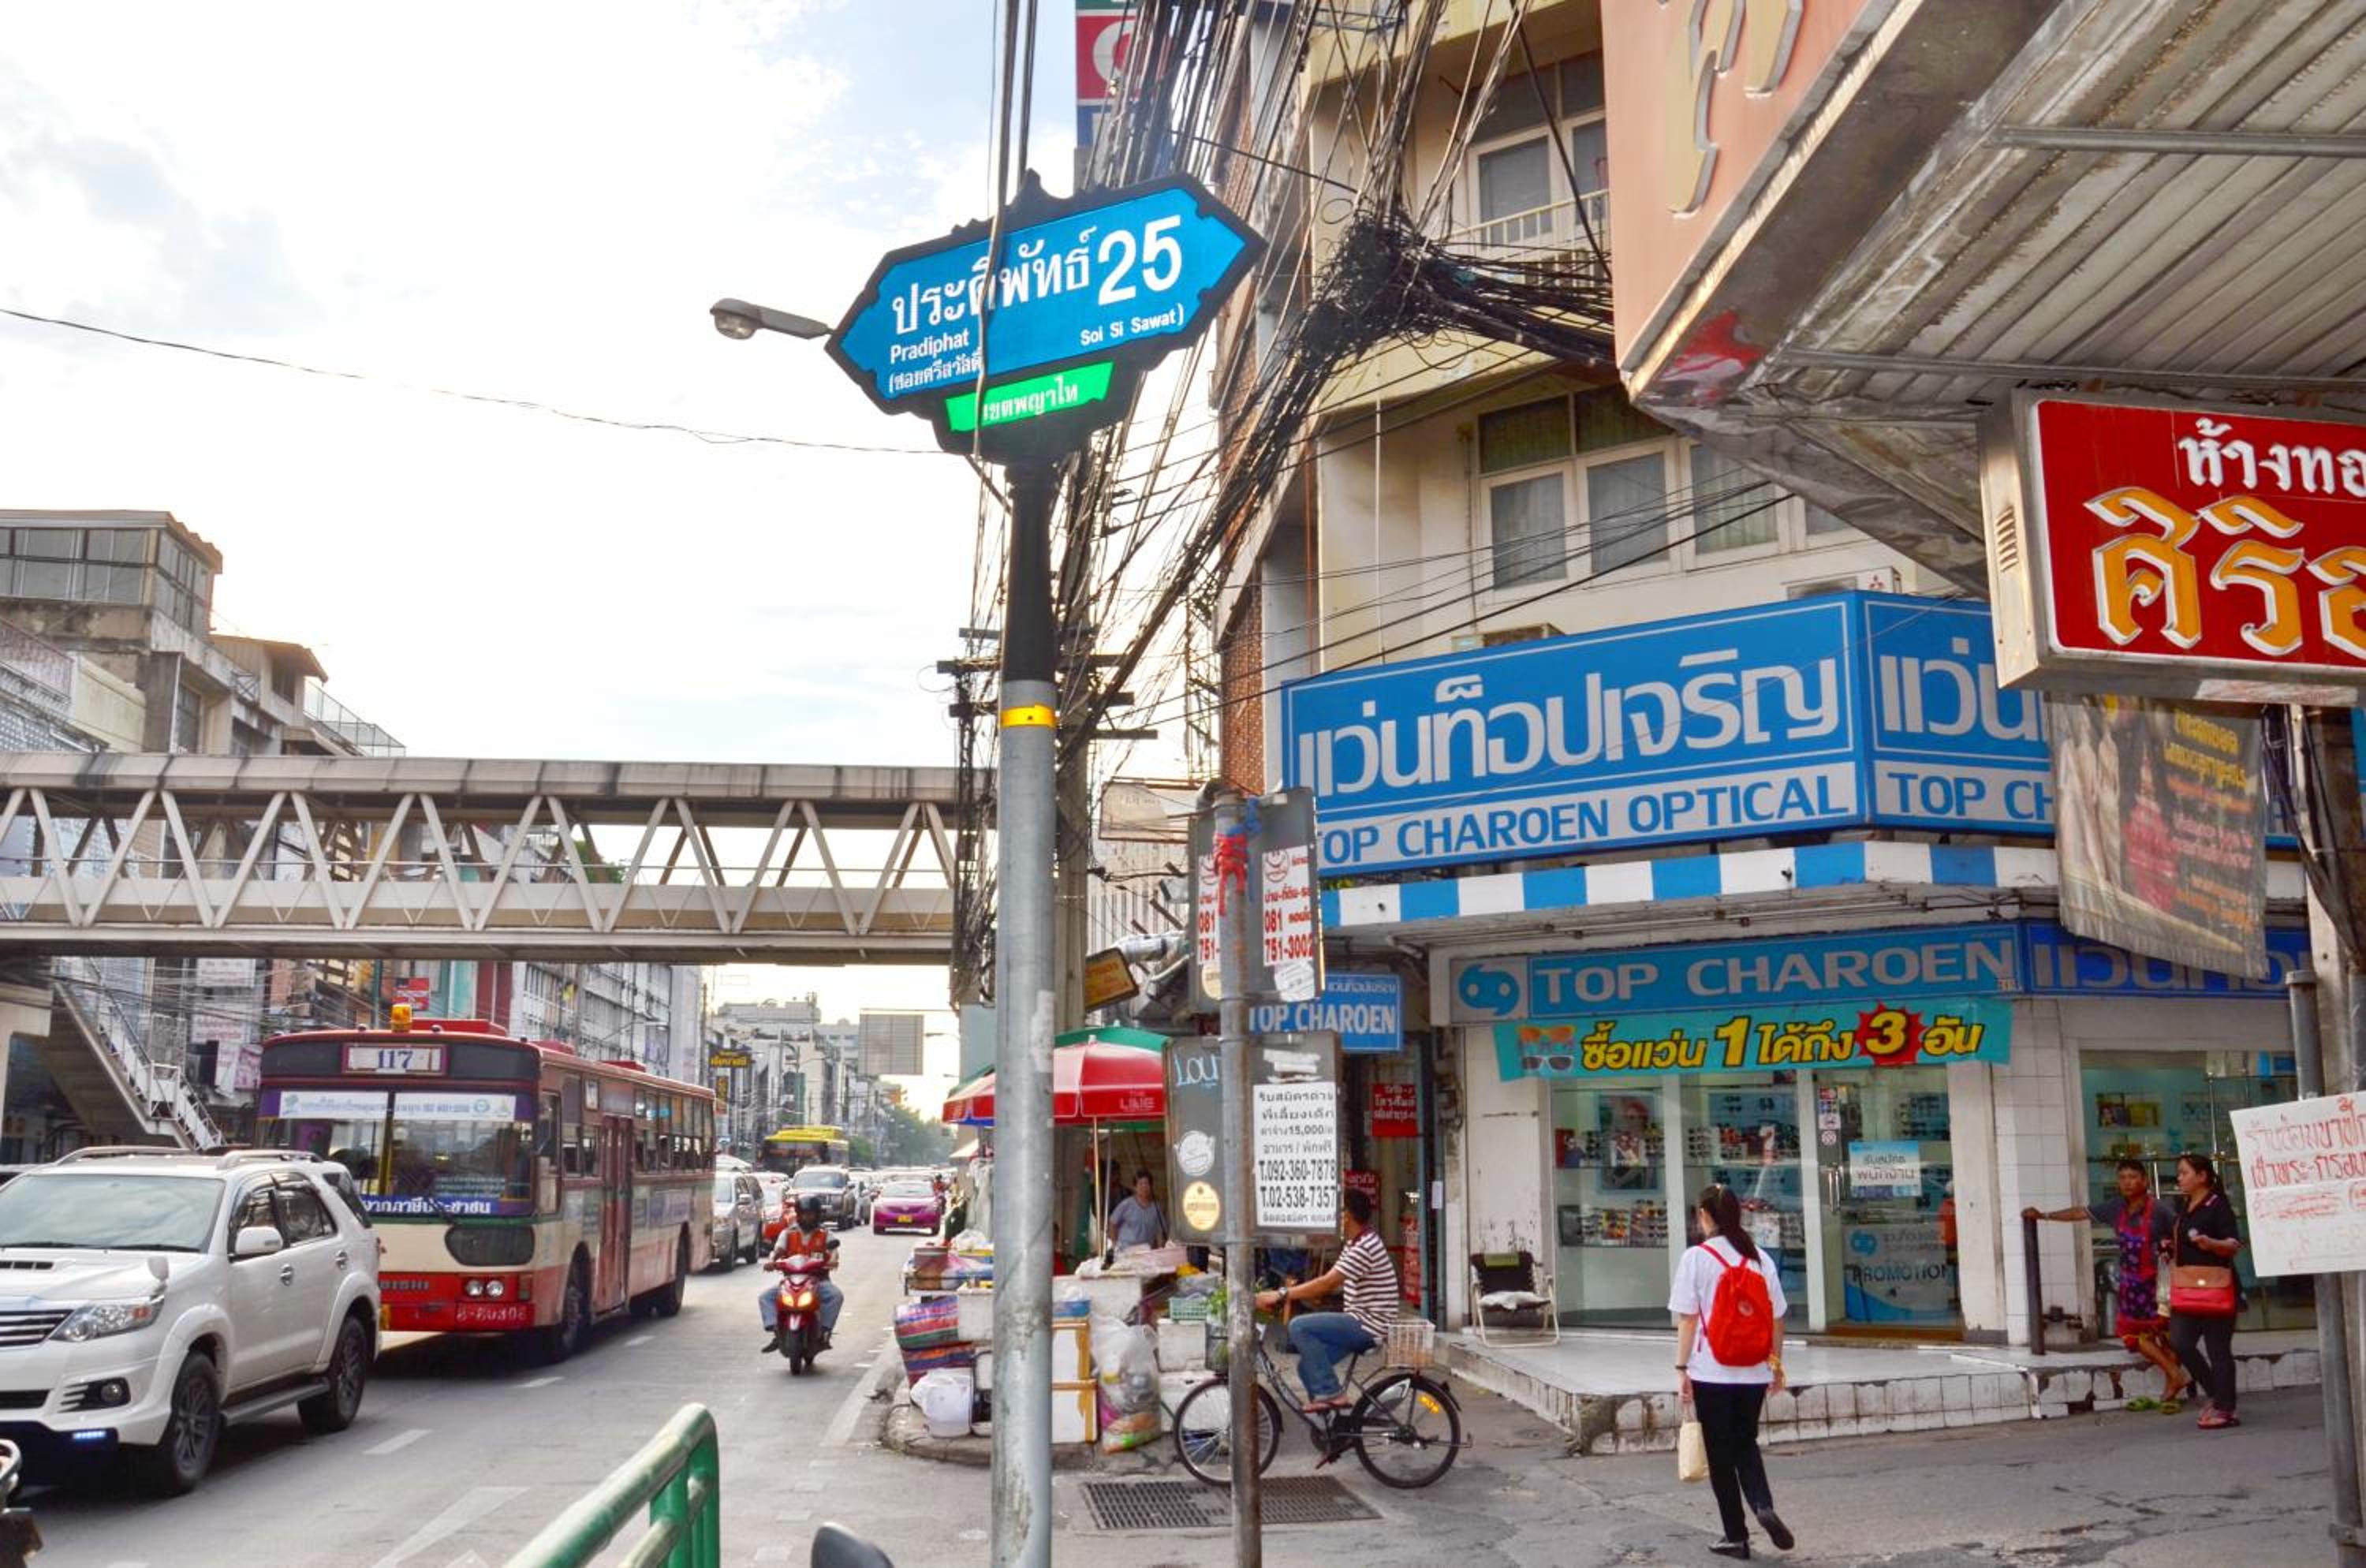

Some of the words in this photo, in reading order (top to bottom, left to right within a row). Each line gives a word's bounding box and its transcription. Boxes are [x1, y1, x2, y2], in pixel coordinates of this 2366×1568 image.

[1097, 214, 1182, 306] 25
[890, 327, 970, 364] Pradiphat
[1080, 329, 1103, 345] Soi
[1110, 322, 1123, 338] Si
[1298, 648, 1839, 797] แว่นท็อปเจริญ
[1318, 824, 1379, 864] OP
[1398, 799, 1609, 857] CHAROEN
[1629, 776, 1849, 833] OPTICAL
[1888, 772, 1985, 816] TOP
[1265, 909, 1282, 933] 081
[1534, 961, 1658, 1003] TOP
[1687, 940, 2013, 997] CHAROEN
[1295, 1003, 1397, 1035] CHAROEN
[1582, 1021, 1707, 1071] ซื้อแว่น
[1715, 1017, 1750, 1067] 1
[1757, 1021, 1854, 1064] ได้ถึง
[1860, 1010, 1907, 1055] 3
[1922, 1017, 1983, 1055] อัน
[375, 1050, 413, 1069] 117
